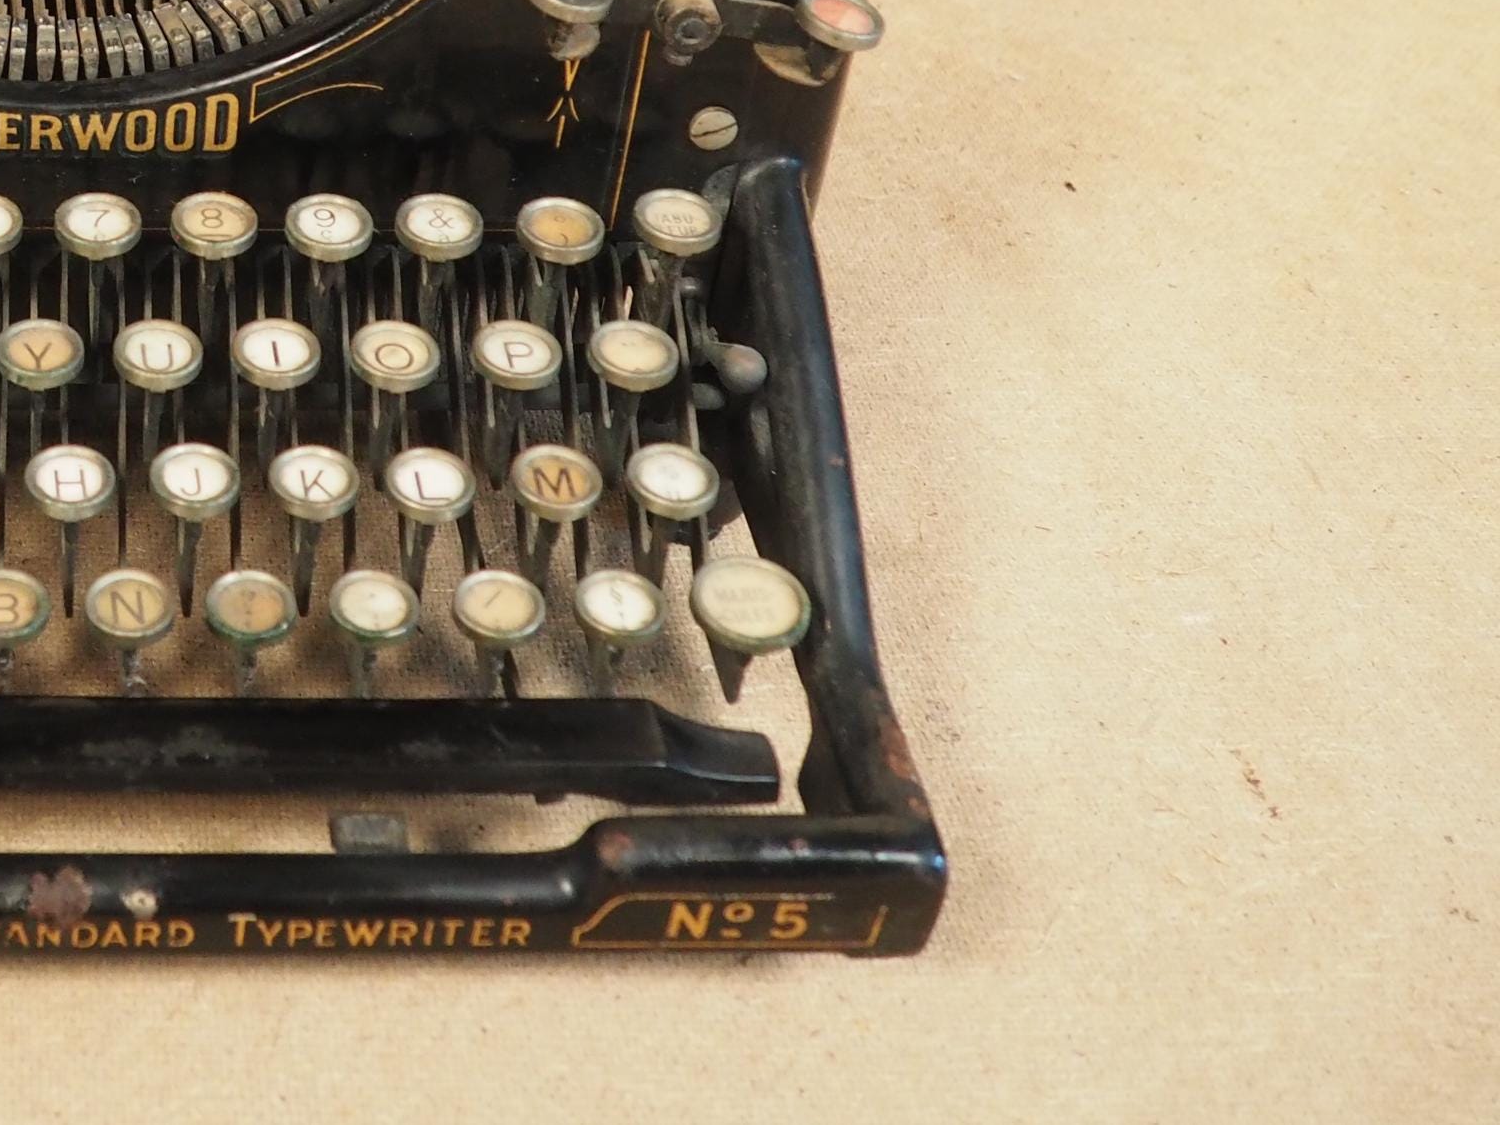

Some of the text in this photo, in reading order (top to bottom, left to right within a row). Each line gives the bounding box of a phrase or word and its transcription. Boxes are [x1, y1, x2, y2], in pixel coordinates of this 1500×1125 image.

[86, 209, 111, 228] 7
[201, 208, 224, 229] 8
[313, 208, 336, 228] 9
[428, 208, 456, 229] &
[23, 342, 53, 370] Y
[140, 342, 173, 372] U
[271, 339, 281, 368] I
[374, 342, 414, 371] O
[503, 340, 534, 369] P
[54, 468, 88, 500] H
[179, 467, 202, 498] J
[300, 468, 334, 499] K
[414, 469, 452, 501] L
[532, 466, 576, 498] M
[109, 589, 144, 625] N
[227, 912, 533, 951] TYPEWRITER
[770, 901, 812, 939] 5
